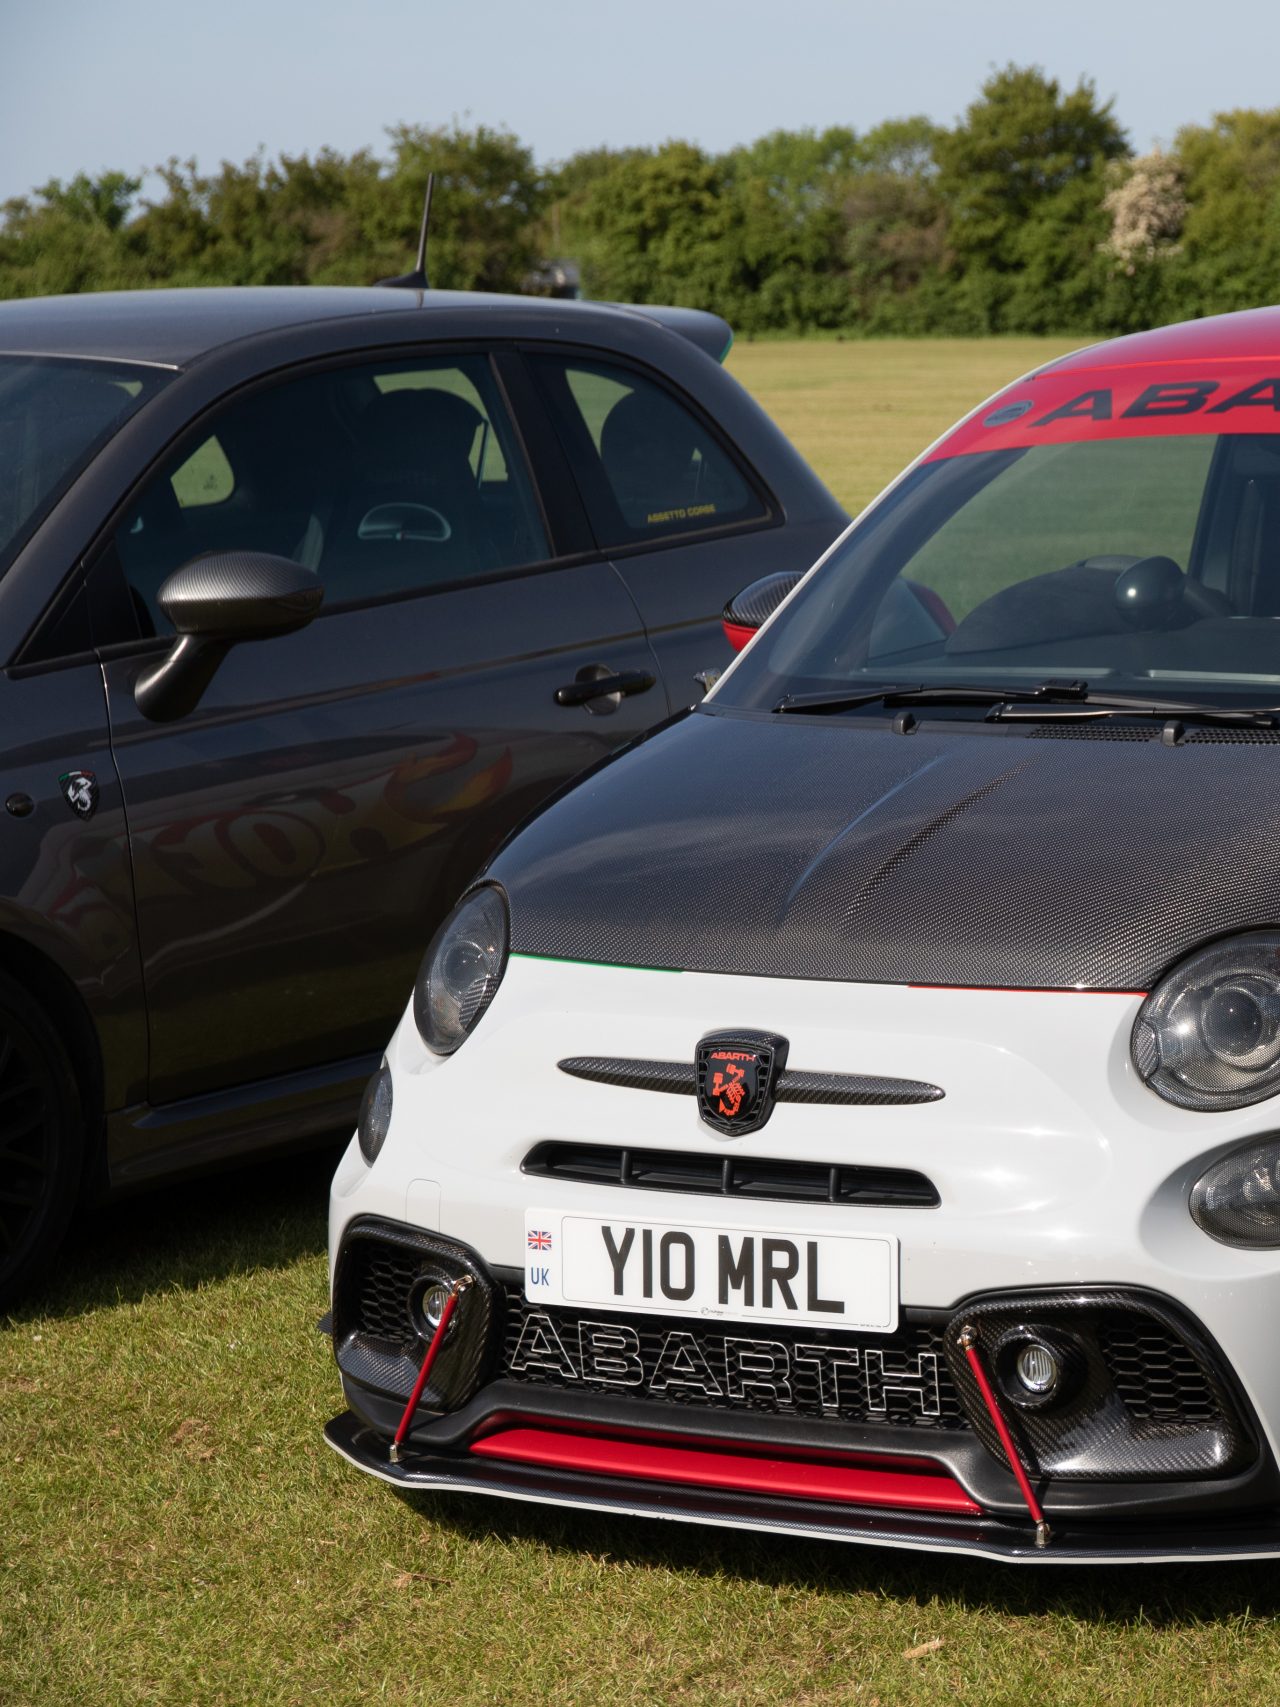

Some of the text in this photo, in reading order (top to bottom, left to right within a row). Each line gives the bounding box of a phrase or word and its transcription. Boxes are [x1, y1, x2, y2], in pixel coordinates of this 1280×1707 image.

[710, 1050, 757, 1062] ABARTH
[529, 1265, 550, 1287] UK
[601, 1225, 845, 1314] Y10 MRL
[510, 1313, 941, 1415] ABARTH
